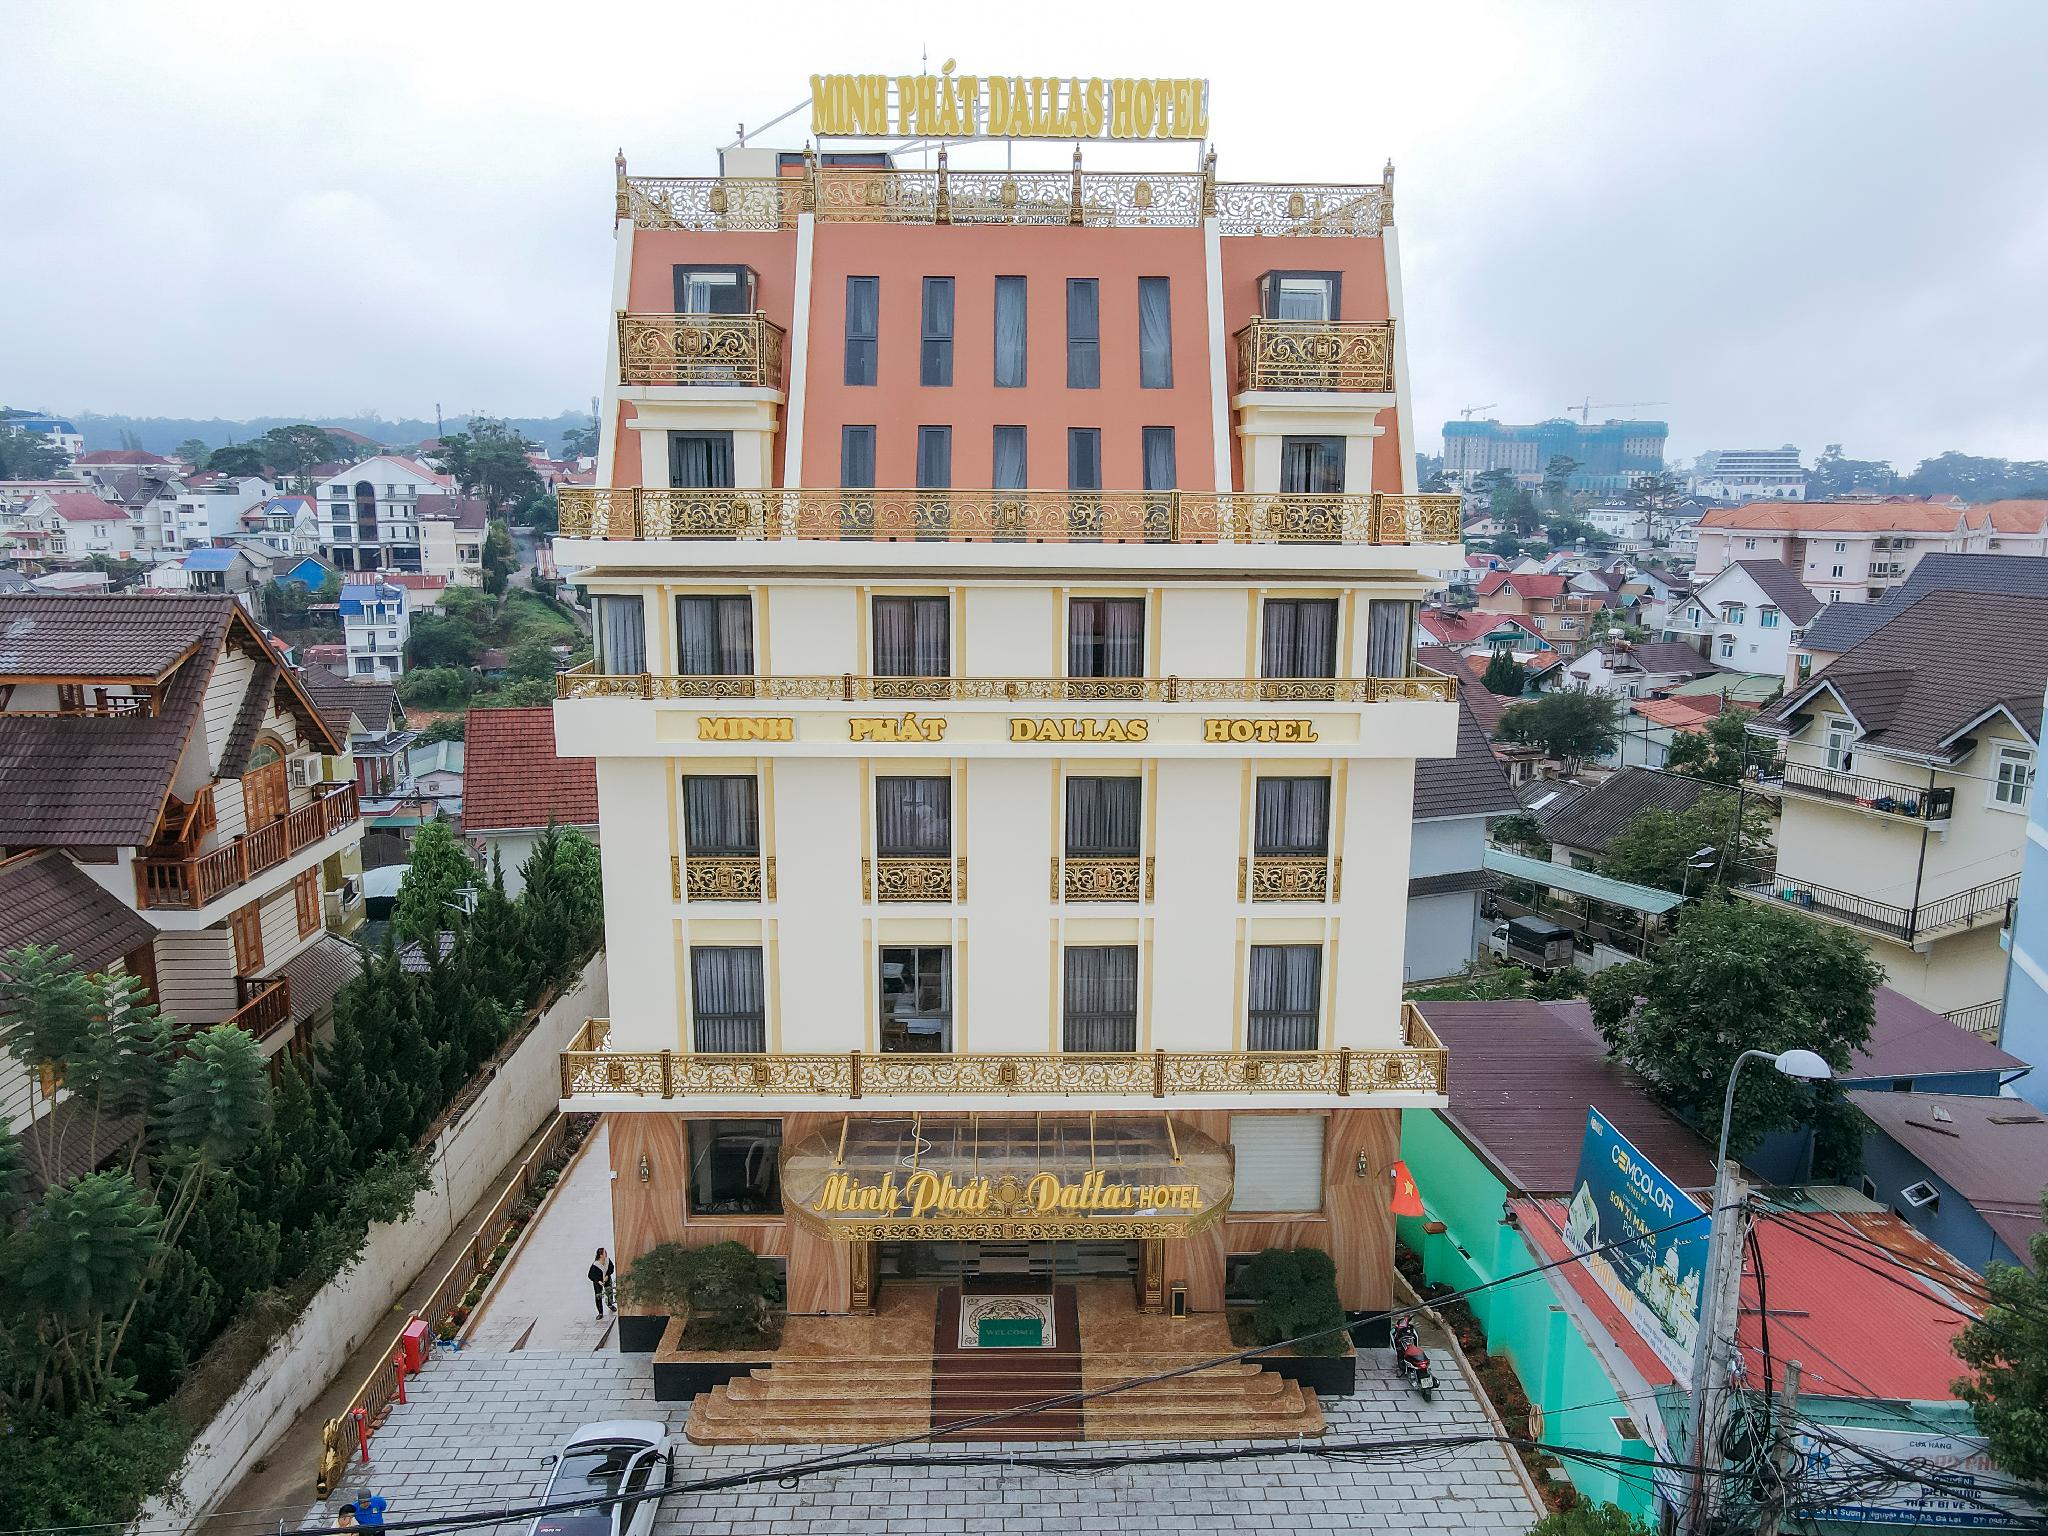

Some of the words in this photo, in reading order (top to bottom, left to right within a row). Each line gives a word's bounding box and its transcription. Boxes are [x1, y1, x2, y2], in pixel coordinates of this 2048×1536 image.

[810, 74, 888, 136] MINH
[898, 58, 978, 137] PHÁT
[987, 76, 1104, 138] DALLAS
[1110, 77, 1208, 139] HOTEL
[698, 716, 795, 743] MINH
[848, 712, 947, 743] PHÁT
[1010, 717, 1149, 743] DALLAS
[1203, 717, 1319, 743] HOTEL
[813, 1170, 900, 1212] Minh
[906, 1169, 990, 1218] Phát
[1027, 1169, 1136, 1212] Dallas
[1139, 1184, 1203, 1209] HOTEL
[1612, 1145, 1673, 1218] CEMCOLOR
